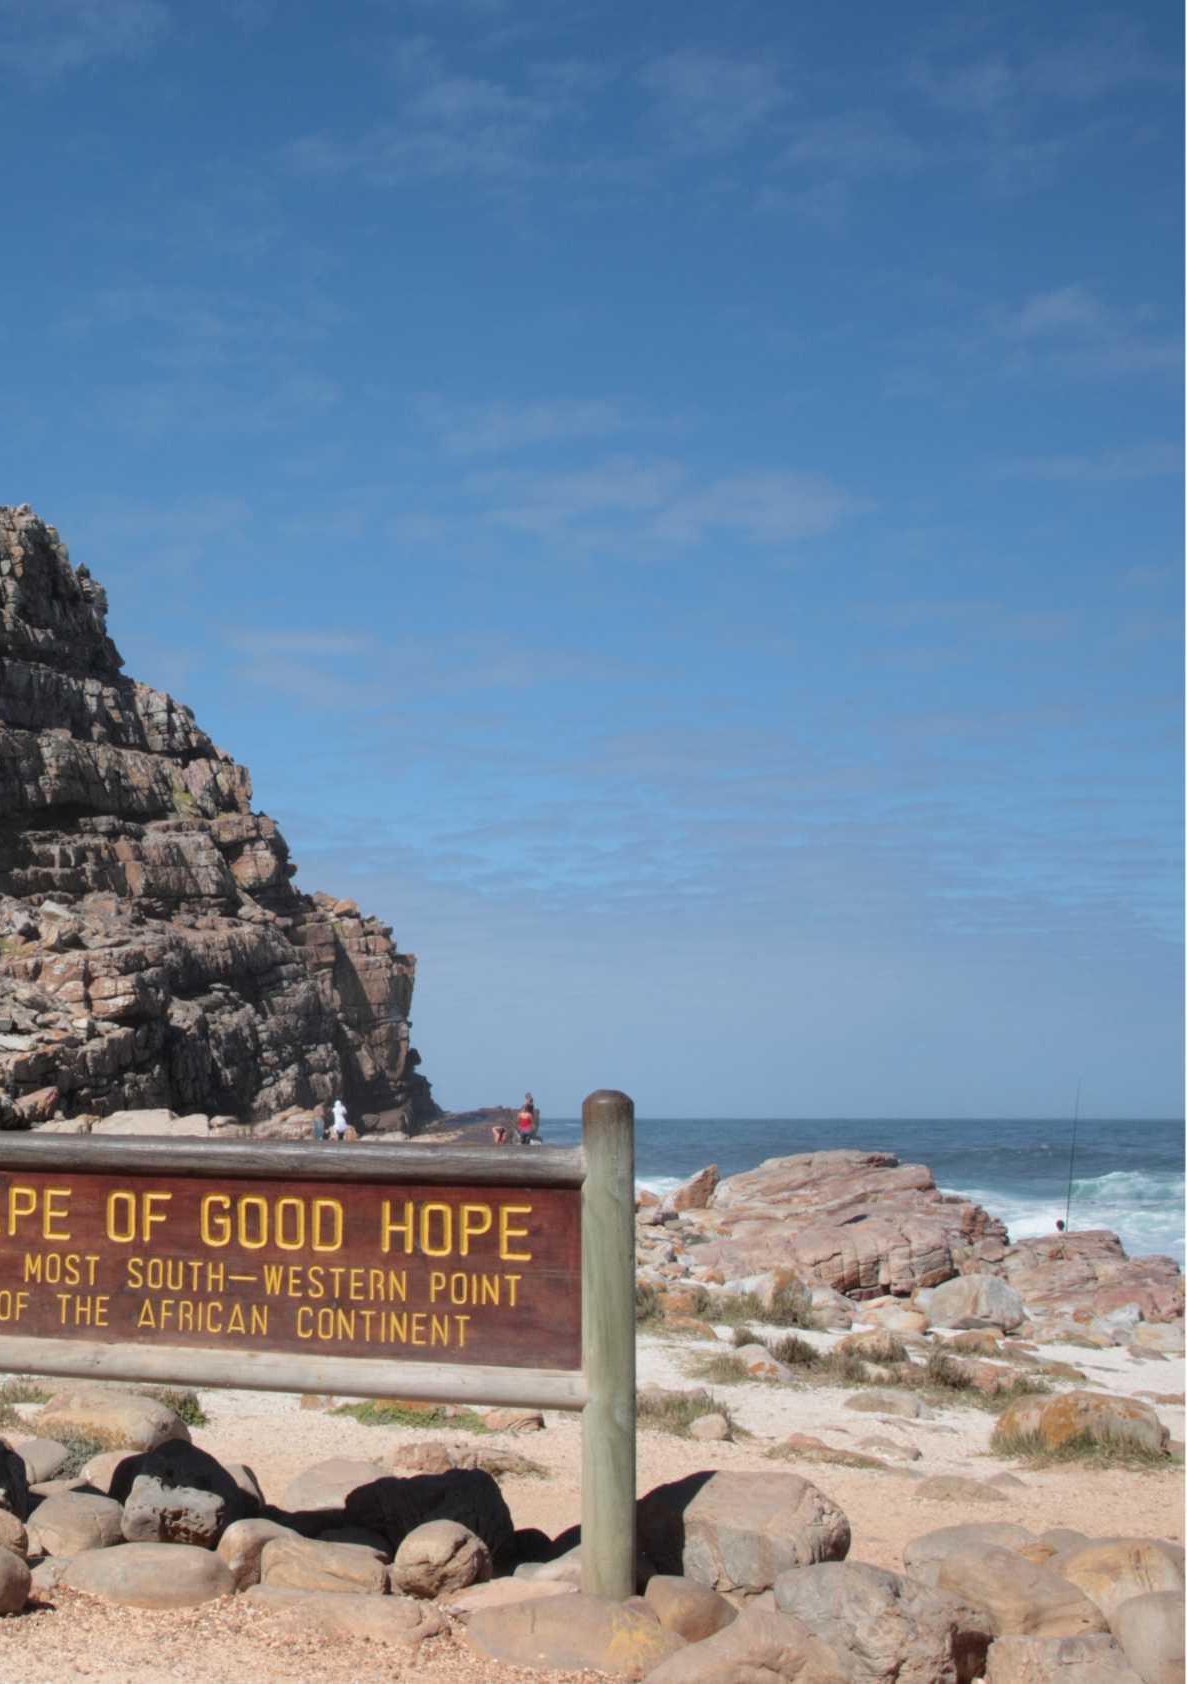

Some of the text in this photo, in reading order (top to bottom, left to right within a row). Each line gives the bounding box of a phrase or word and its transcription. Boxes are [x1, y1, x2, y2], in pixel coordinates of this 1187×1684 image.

[106, 1190, 173, 1244] OF
[200, 1194, 343, 1253] GOOD
[380, 1200, 533, 1261] HOPE
[24, 1252, 101, 1286] MOST
[429, 1271, 522, 1307] POINT
[56, 1293, 110, 1327] THE
[137, 1298, 268, 1336] AFRICAN
[296, 1306, 471, 1348] CONTINENT
